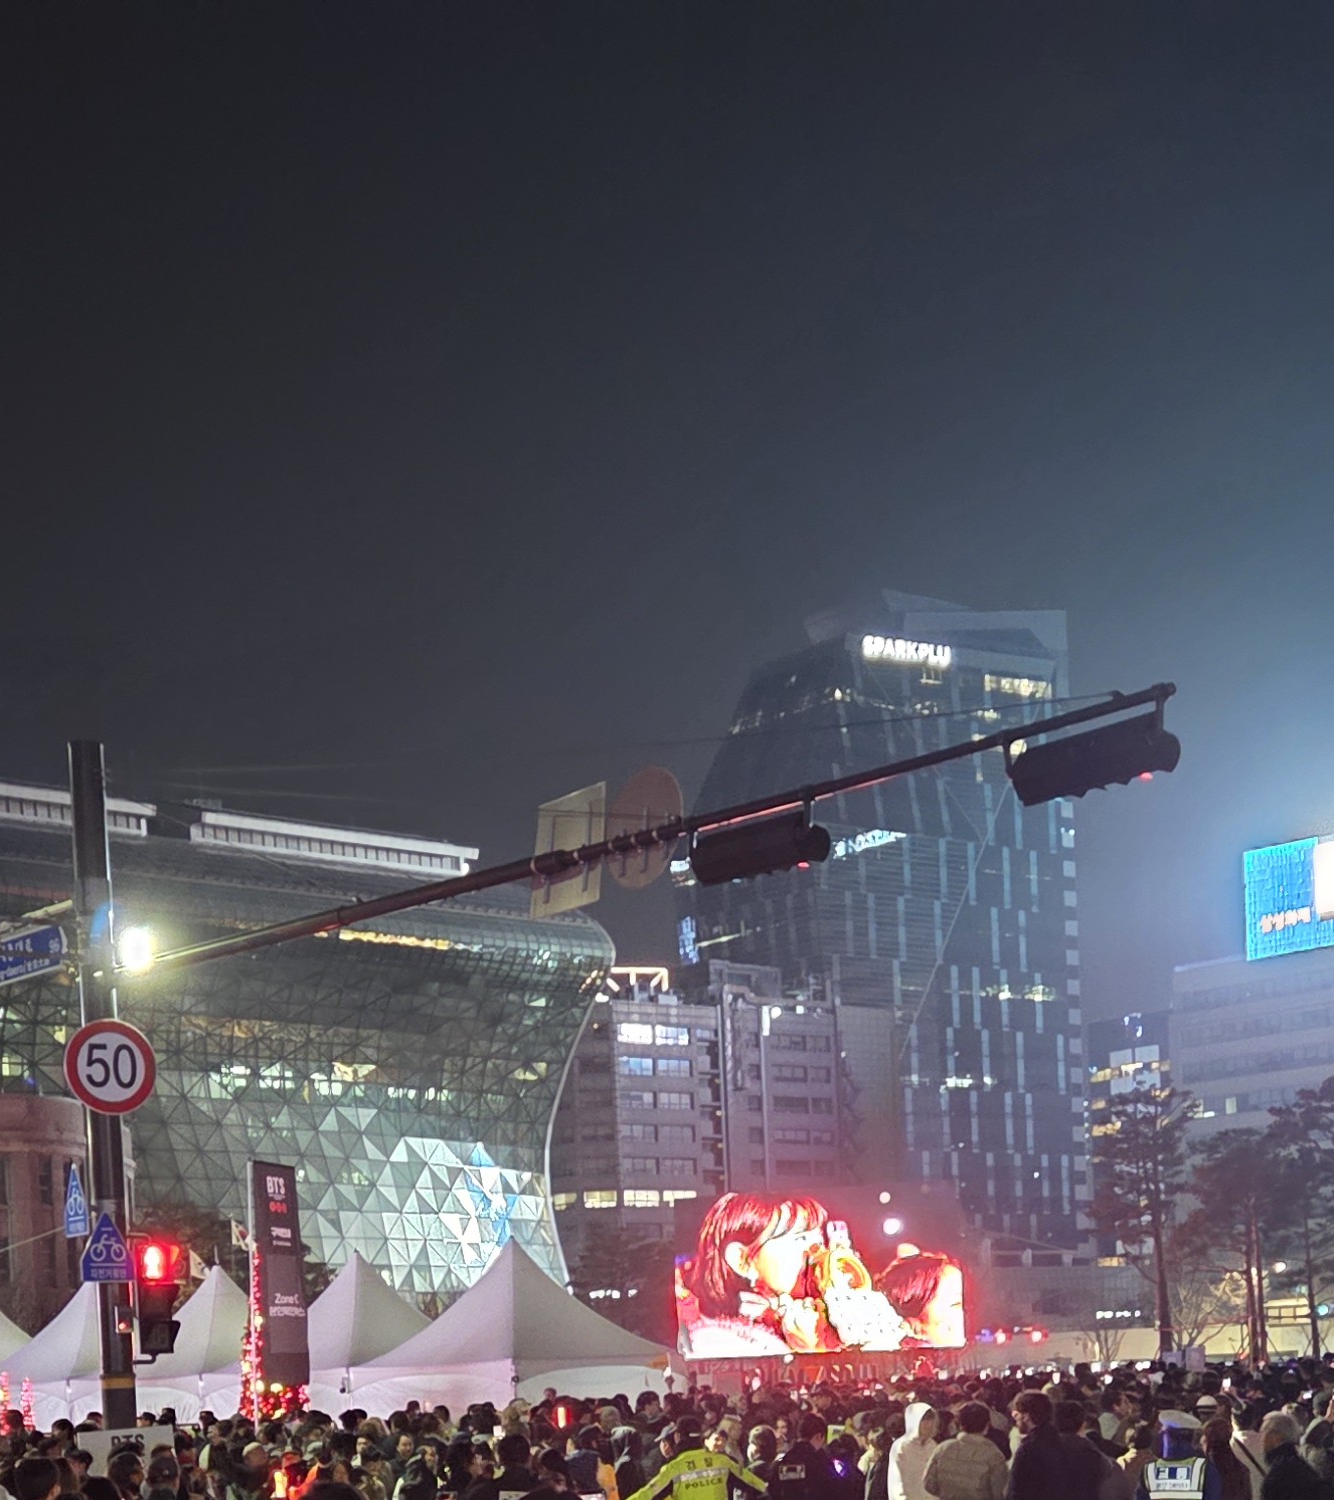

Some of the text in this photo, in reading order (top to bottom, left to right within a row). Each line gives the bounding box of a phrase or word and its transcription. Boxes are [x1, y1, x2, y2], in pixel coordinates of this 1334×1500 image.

[86, 1043, 137, 1089] 50
[266, 1176, 285, 1195] BTS
[684, 1478, 723, 1490] POLICE
